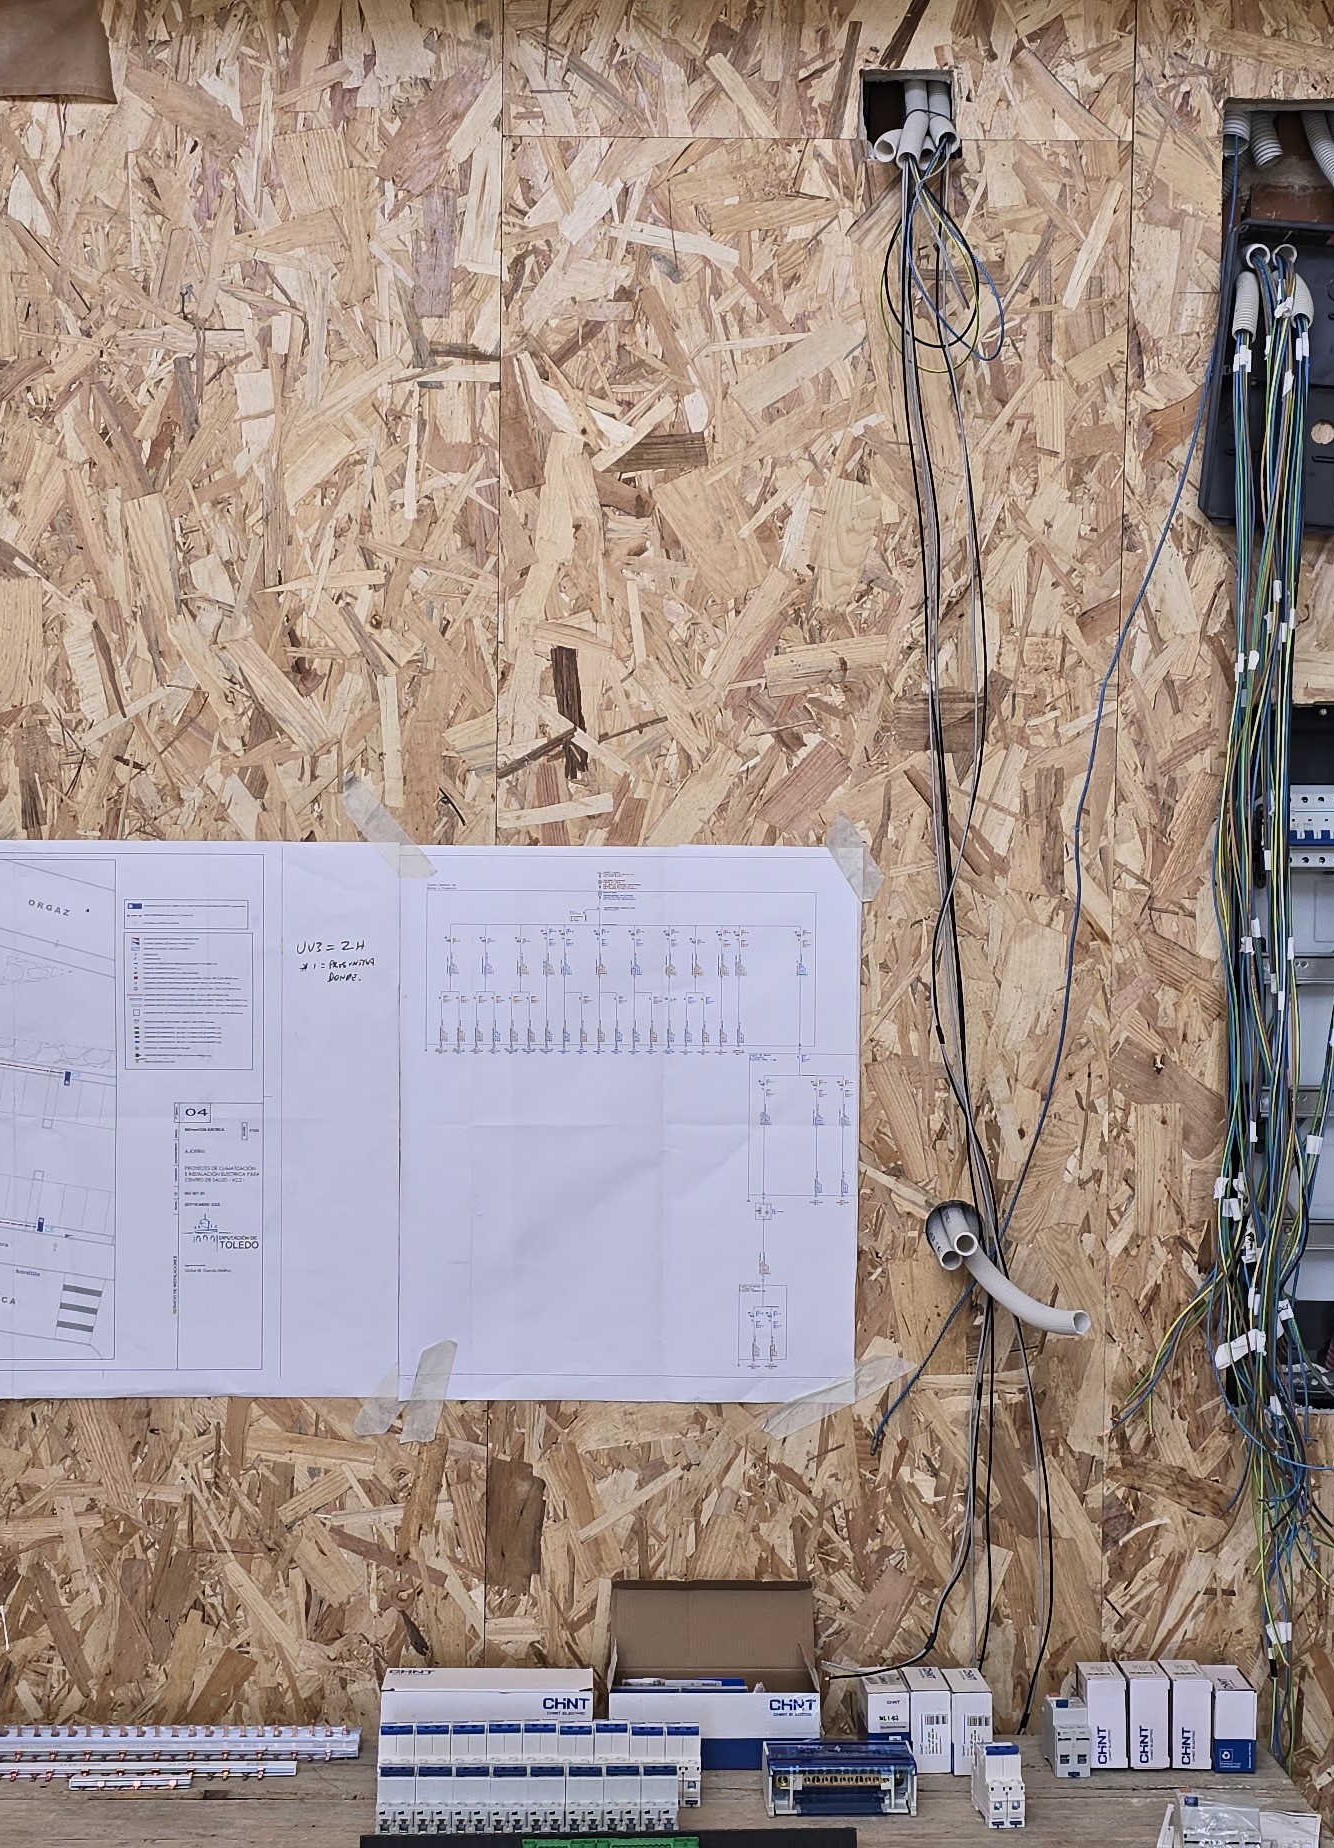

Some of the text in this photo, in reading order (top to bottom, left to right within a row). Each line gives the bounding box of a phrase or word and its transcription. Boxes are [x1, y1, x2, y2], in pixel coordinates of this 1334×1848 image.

[28, 899, 71, 917] ORGAZ
[185, 1108, 208, 1117] 04
[220, 1240, 260, 1250] TOLEDO
